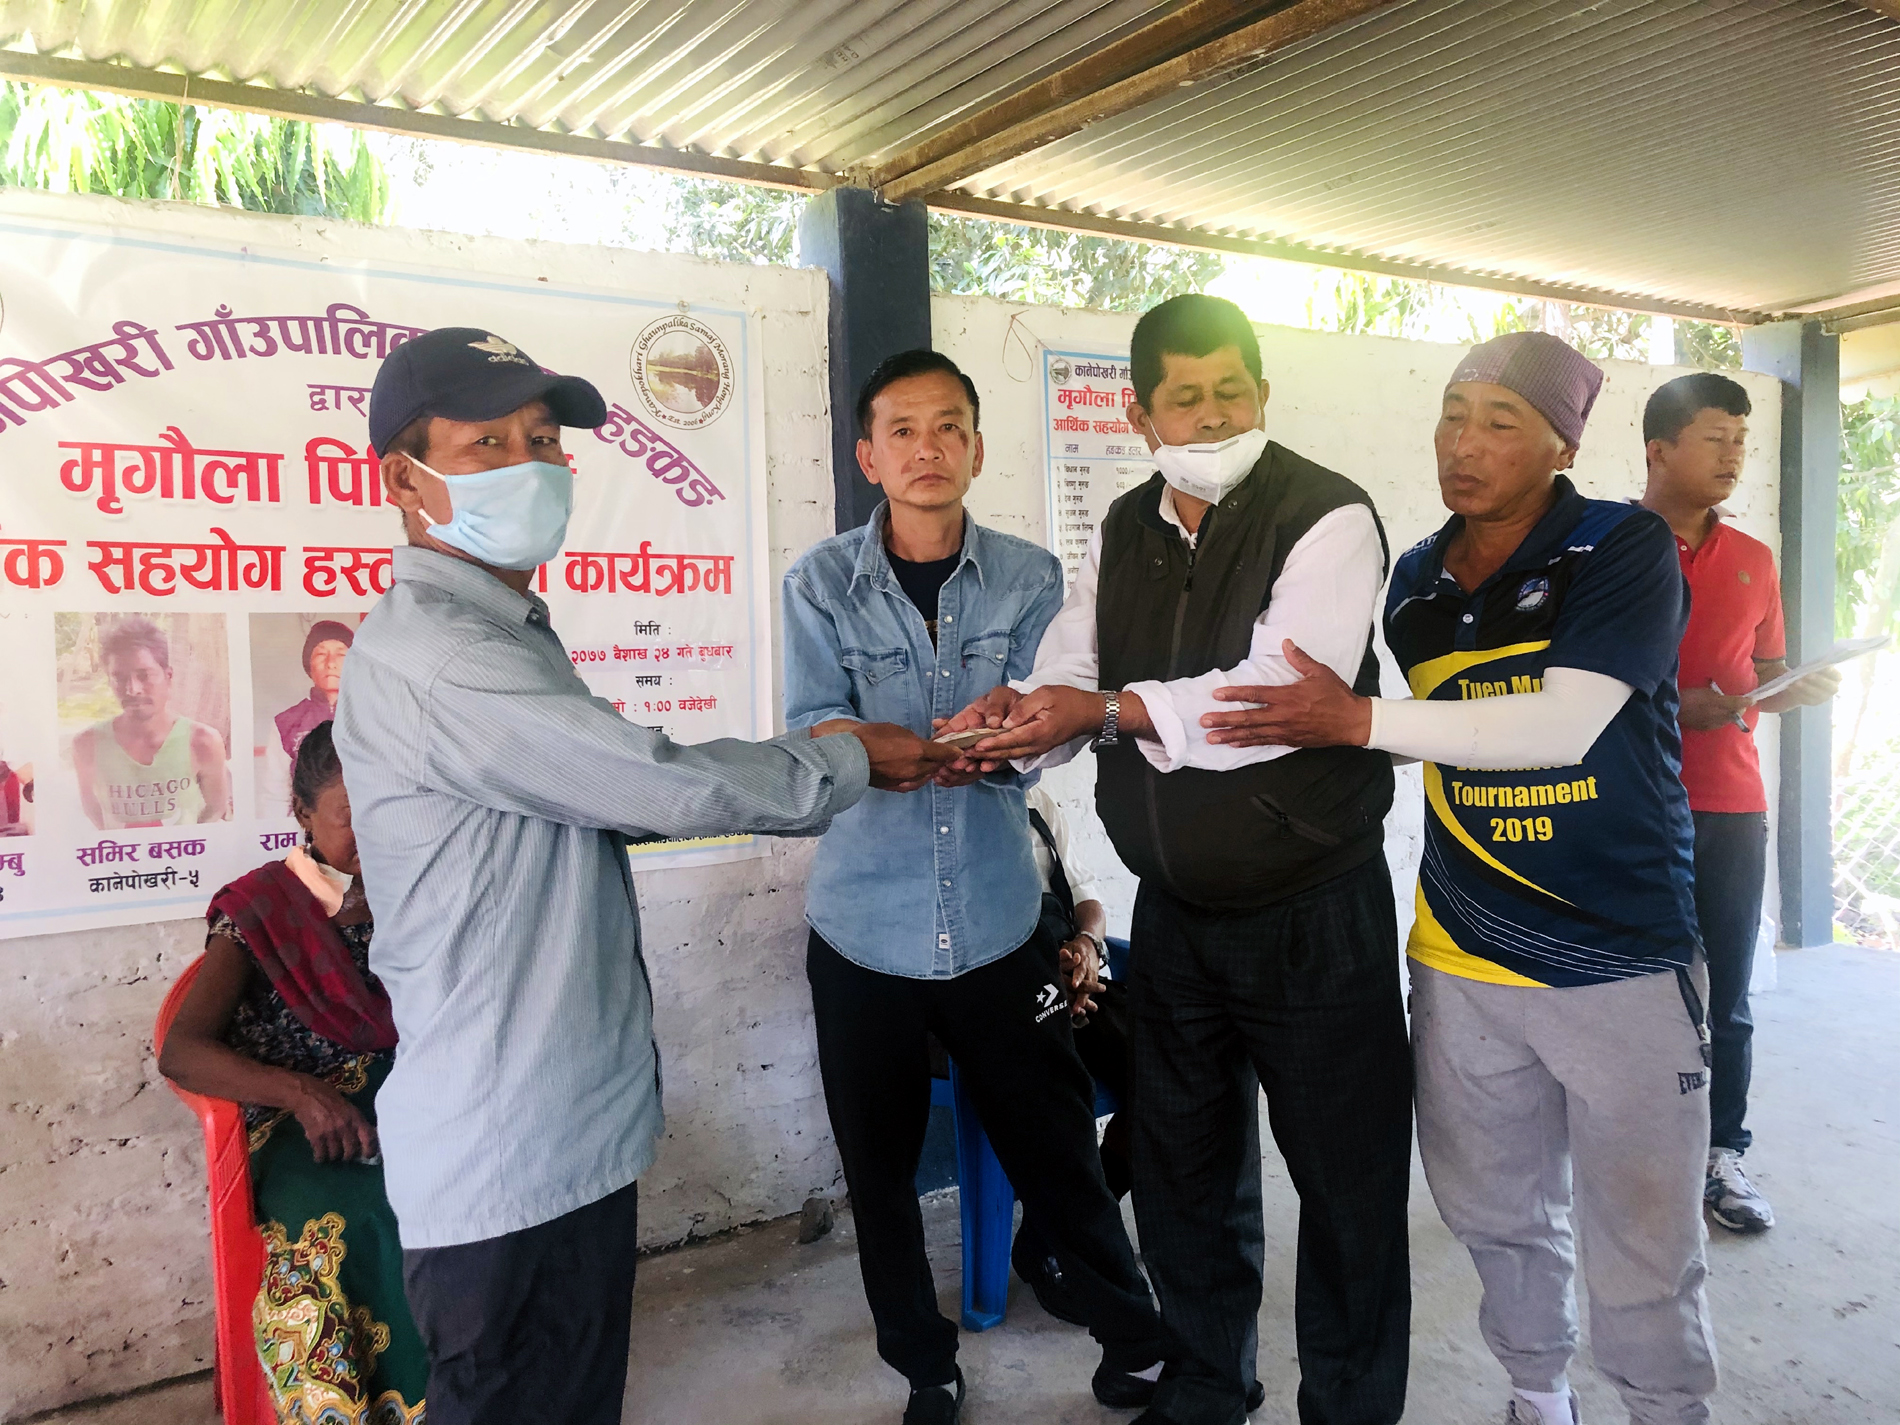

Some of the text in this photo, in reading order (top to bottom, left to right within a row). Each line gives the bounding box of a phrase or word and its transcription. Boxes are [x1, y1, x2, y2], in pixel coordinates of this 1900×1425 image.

[0, 321, 174, 433] पोखरी
[1075, 362, 1116, 379] कानेपोखरी
[306, 384, 371, 417] द्वार
[1058, 385, 1116, 410] मृगौला
[1053, 416, 1089, 432] आर्थिक
[1093, 418, 1129, 434] सहयोग
[1065, 443, 1079, 453] नाम
[58, 426, 284, 514] मृगौला
[87, 527, 286, 594] सहयोग
[565, 541, 734, 596] कार्यक्रम
[634, 620, 661, 636] मिति
[571, 649, 606, 664] २०७७
[613, 644, 648, 661] बैशाख
[654, 648, 670, 662] २४
[676, 644, 694, 658] गते
[635, 675, 662, 688] समय
[1511, 675, 1544, 694] Mu
[109, 778, 190, 798] HICAGO
[1452, 776, 1598, 807] Tournament
[1490, 817, 1553, 842] 2019
[76, 839, 206, 866] समिर बसक
[260, 832, 298, 851] राम
